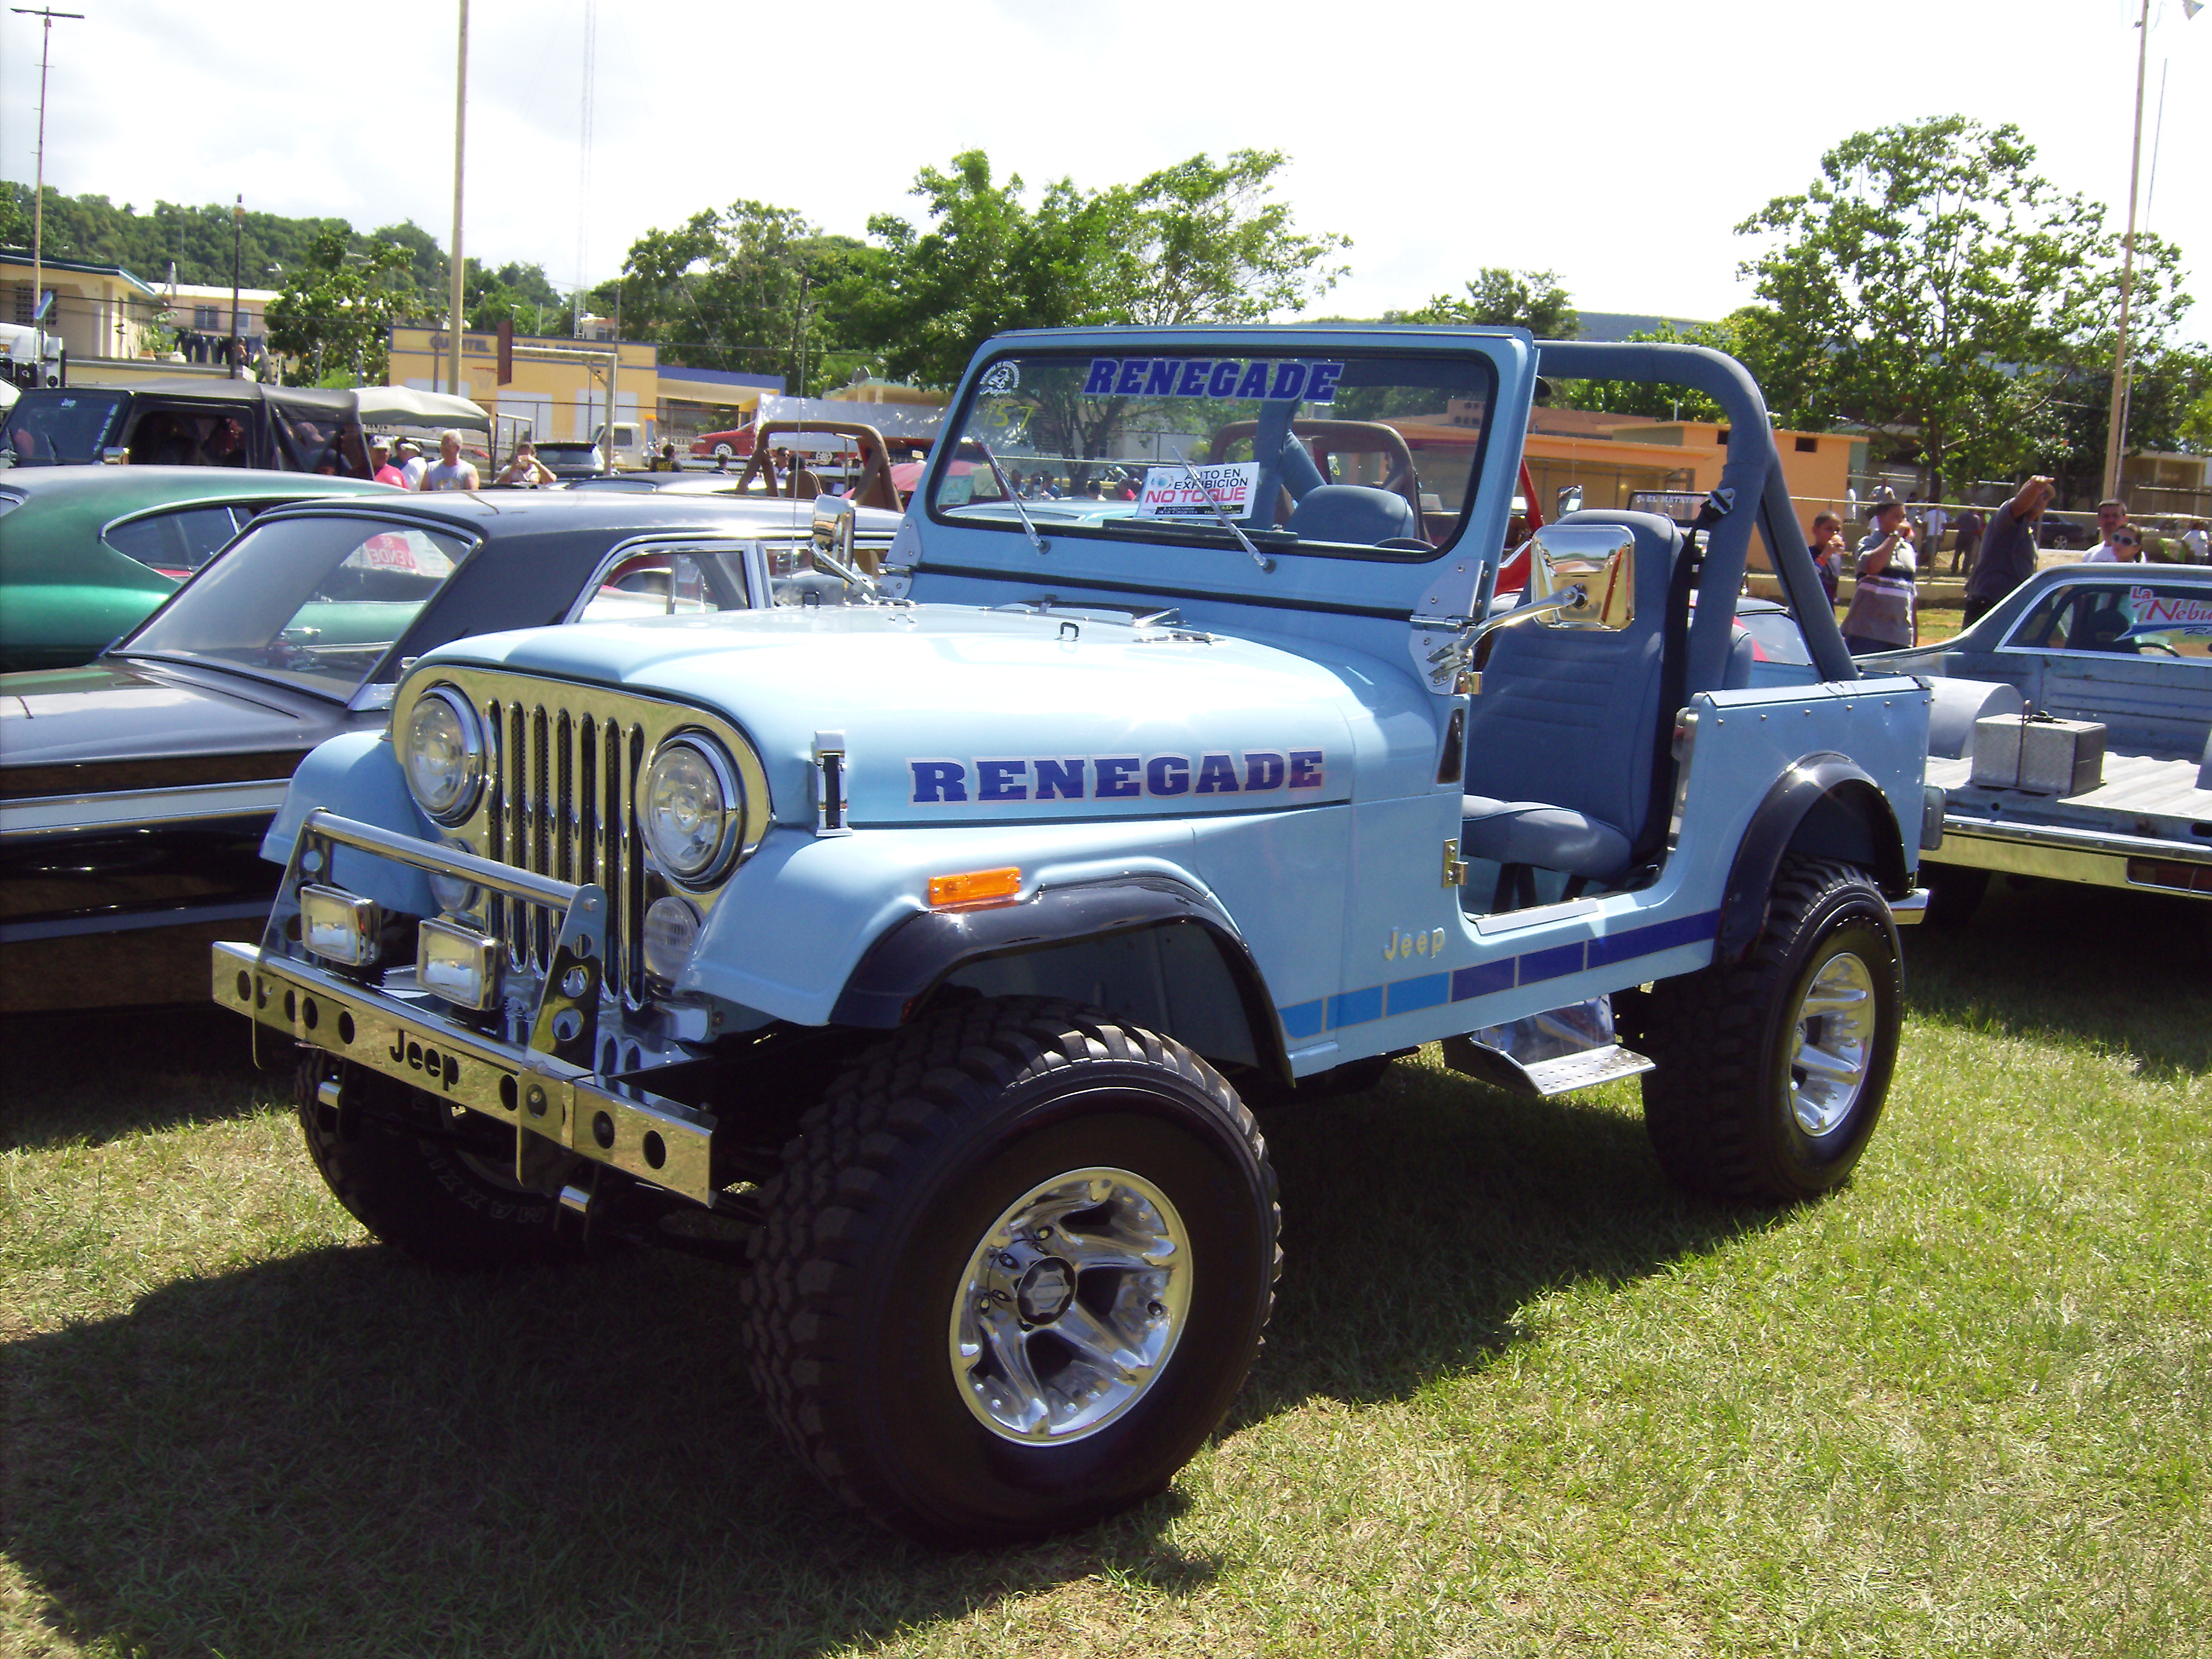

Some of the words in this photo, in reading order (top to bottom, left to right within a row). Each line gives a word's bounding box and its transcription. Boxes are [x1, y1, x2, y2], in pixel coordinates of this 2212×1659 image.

[429, 336, 491, 352] CUTEL
[1083, 360, 1344, 401] RENEGADE
[1224, 468, 1241, 478] EN
[1145, 490, 1176, 503] NO
[1180, 487, 1247, 503] TOQUE
[2133, 587, 2152, 599] La
[908, 749, 1324, 804] RENEGADE
[1382, 927, 1444, 960] Jeep
[389, 1029, 458, 1091] Jeep
